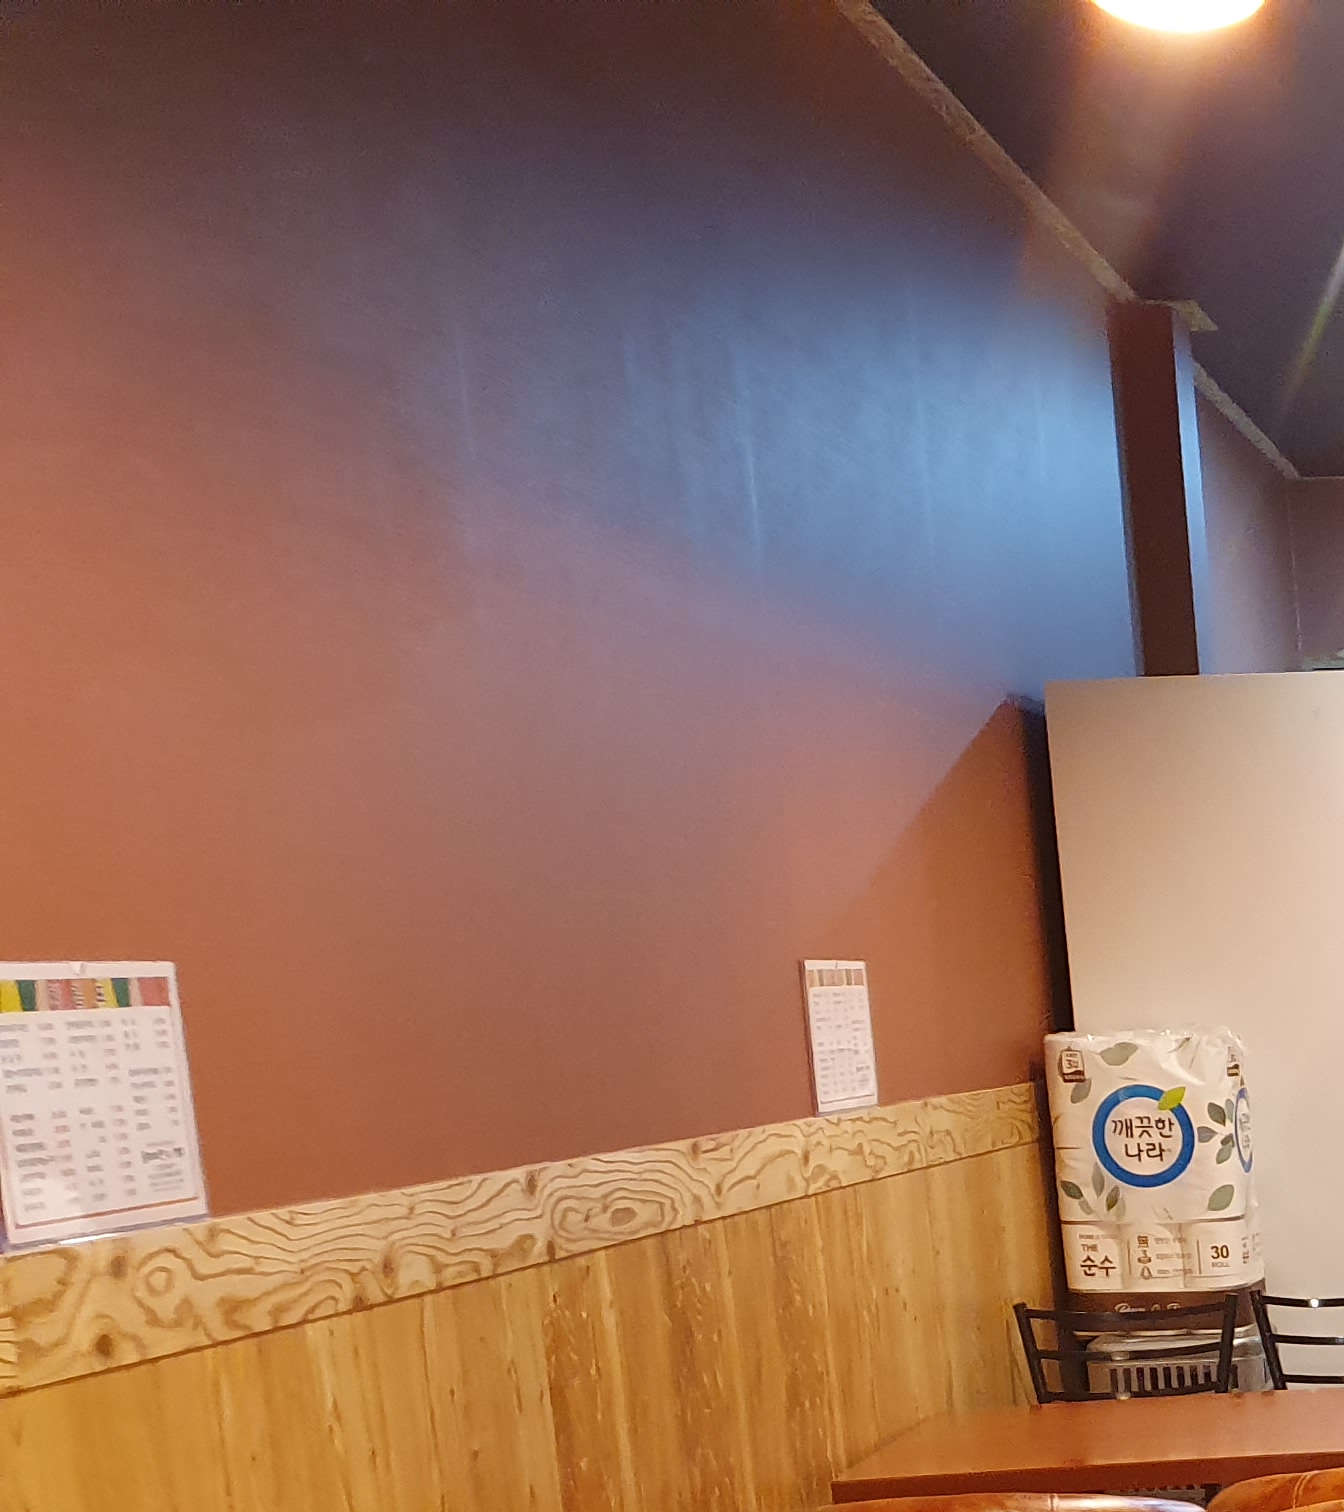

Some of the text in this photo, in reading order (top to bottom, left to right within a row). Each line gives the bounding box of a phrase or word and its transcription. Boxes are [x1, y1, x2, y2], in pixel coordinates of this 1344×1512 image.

[1111, 1115, 1175, 1139] 깨끗한
[1124, 1142, 1167, 1162] 나라
[1210, 1244, 1230, 1260] 30
[1080, 1255, 1117, 1277] 순수
